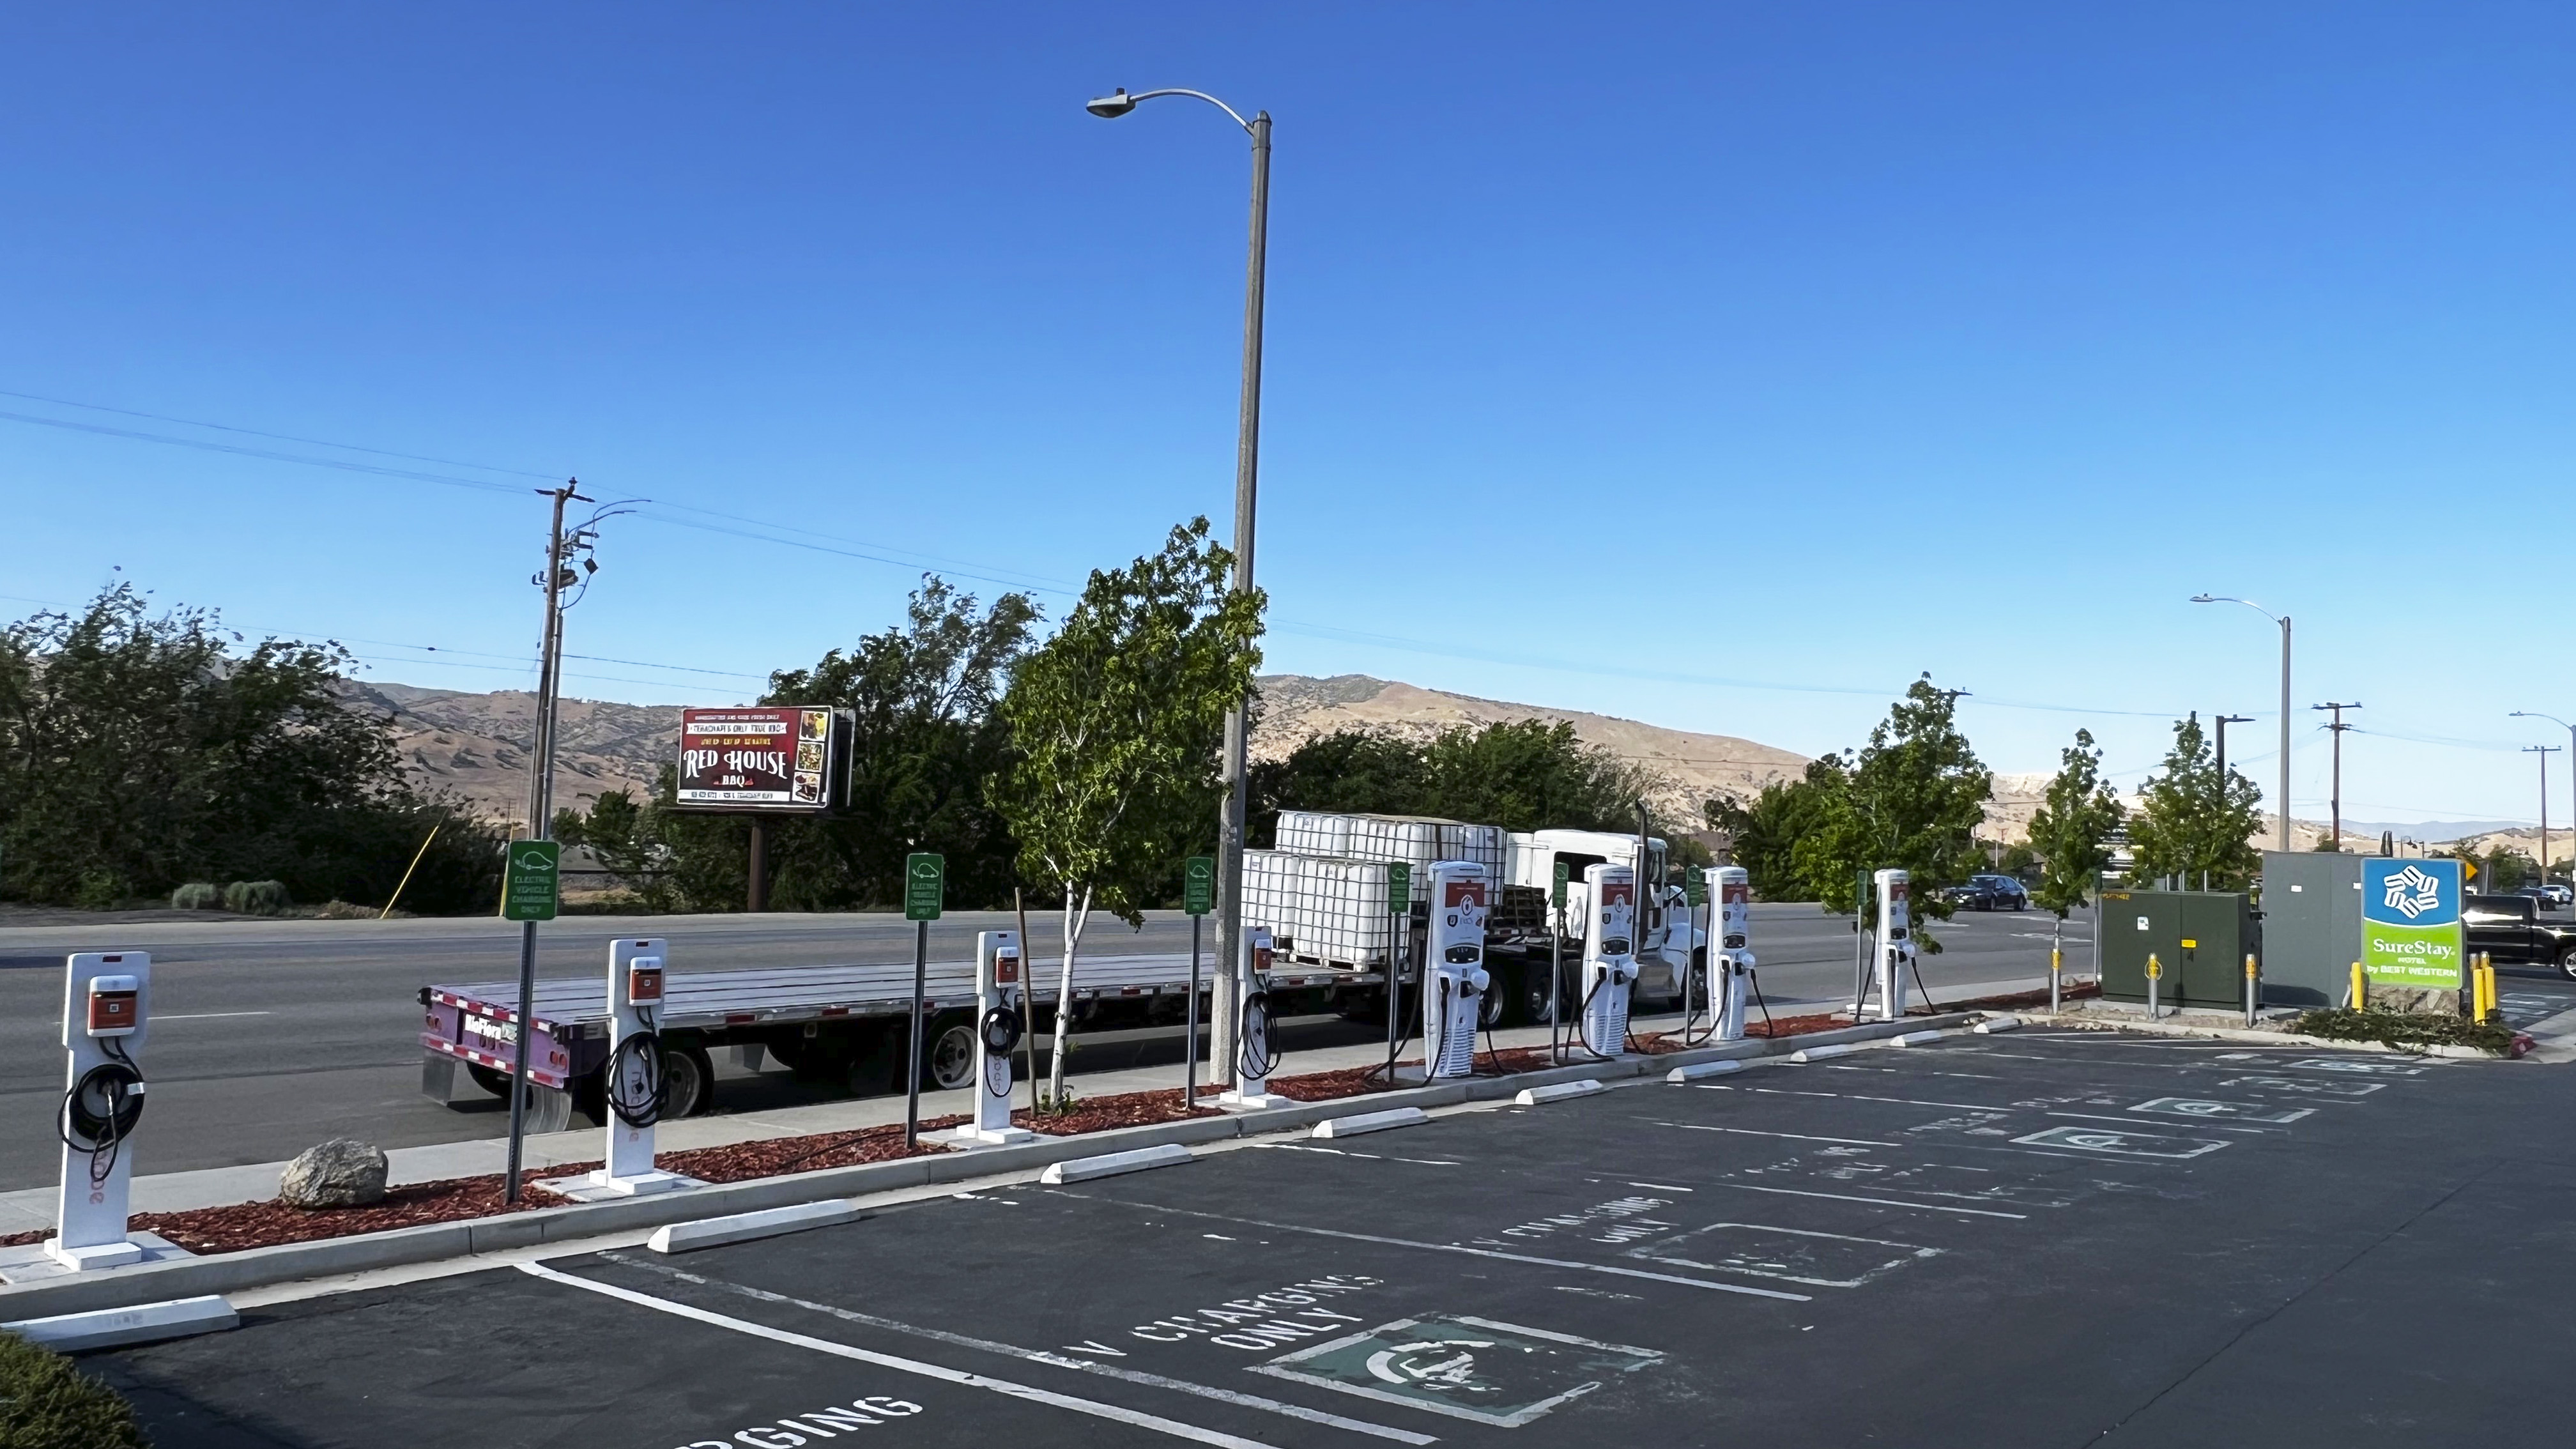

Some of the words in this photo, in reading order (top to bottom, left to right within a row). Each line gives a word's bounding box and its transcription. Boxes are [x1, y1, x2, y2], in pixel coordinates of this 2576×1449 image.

[683, 749, 718, 779] RED
[723, 750, 788, 779] HOUSE
[722, 775, 745, 788] BBQ
[516, 885, 549, 894] VEHICLE
[2373, 938, 2453, 960] SureStay
[2366, 965, 2379, 974] by
[2380, 965, 2407, 974] BEST
[2408, 967, 2457, 977] WESTERN
[464, 1013, 502, 1040] BioFlora
[1128, 1275, 1384, 1341] CHARGING
[1210, 1307, 1363, 1350] ONLY
